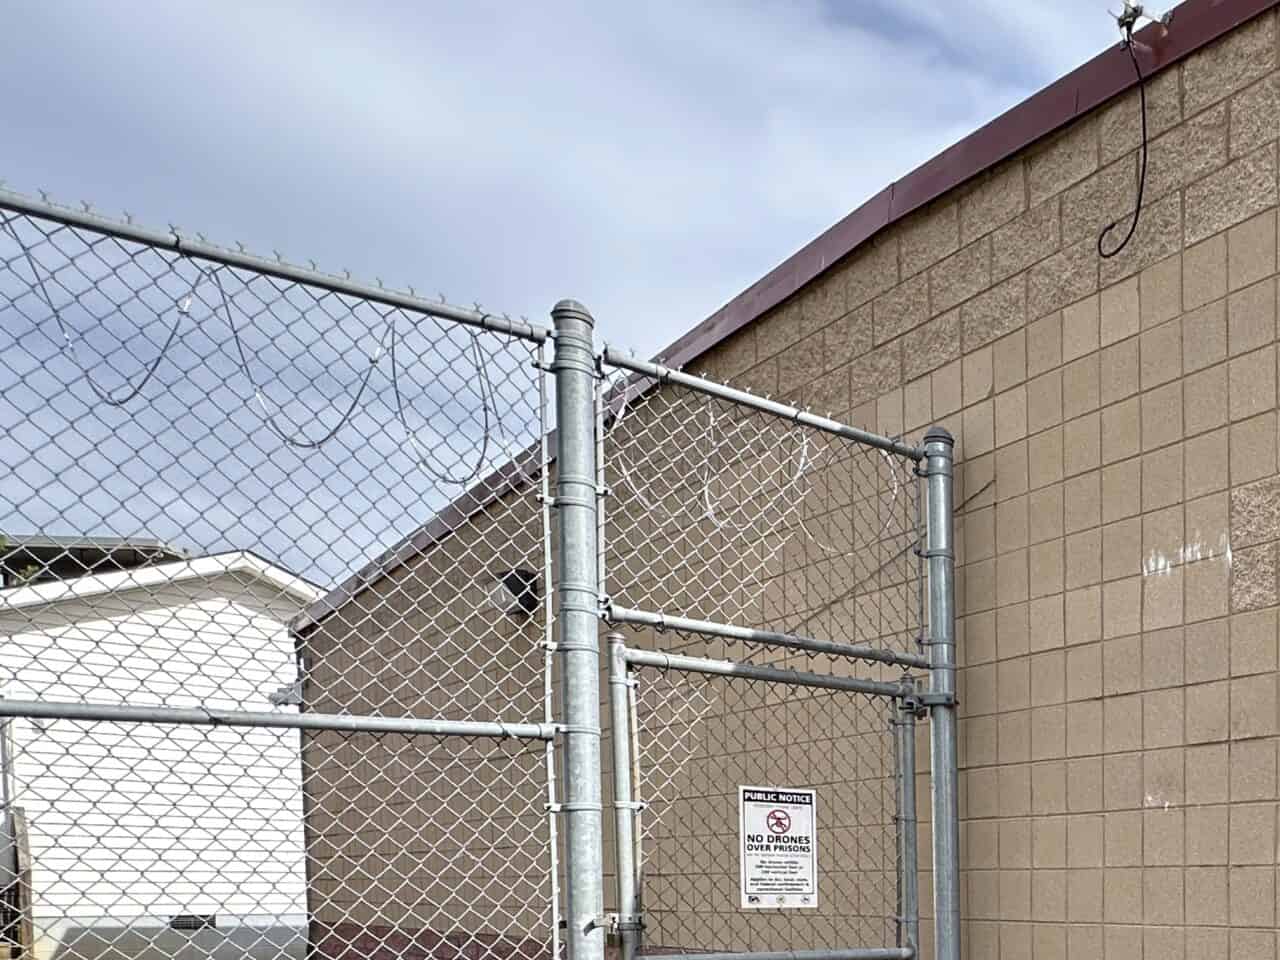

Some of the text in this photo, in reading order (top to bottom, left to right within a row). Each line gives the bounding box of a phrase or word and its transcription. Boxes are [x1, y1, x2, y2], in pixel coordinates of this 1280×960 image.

[744, 791, 811, 803] PUBLIC NOTICE
[747, 834, 811, 844] NO DRONES
[747, 843, 811, 853] OVER PRISONS
